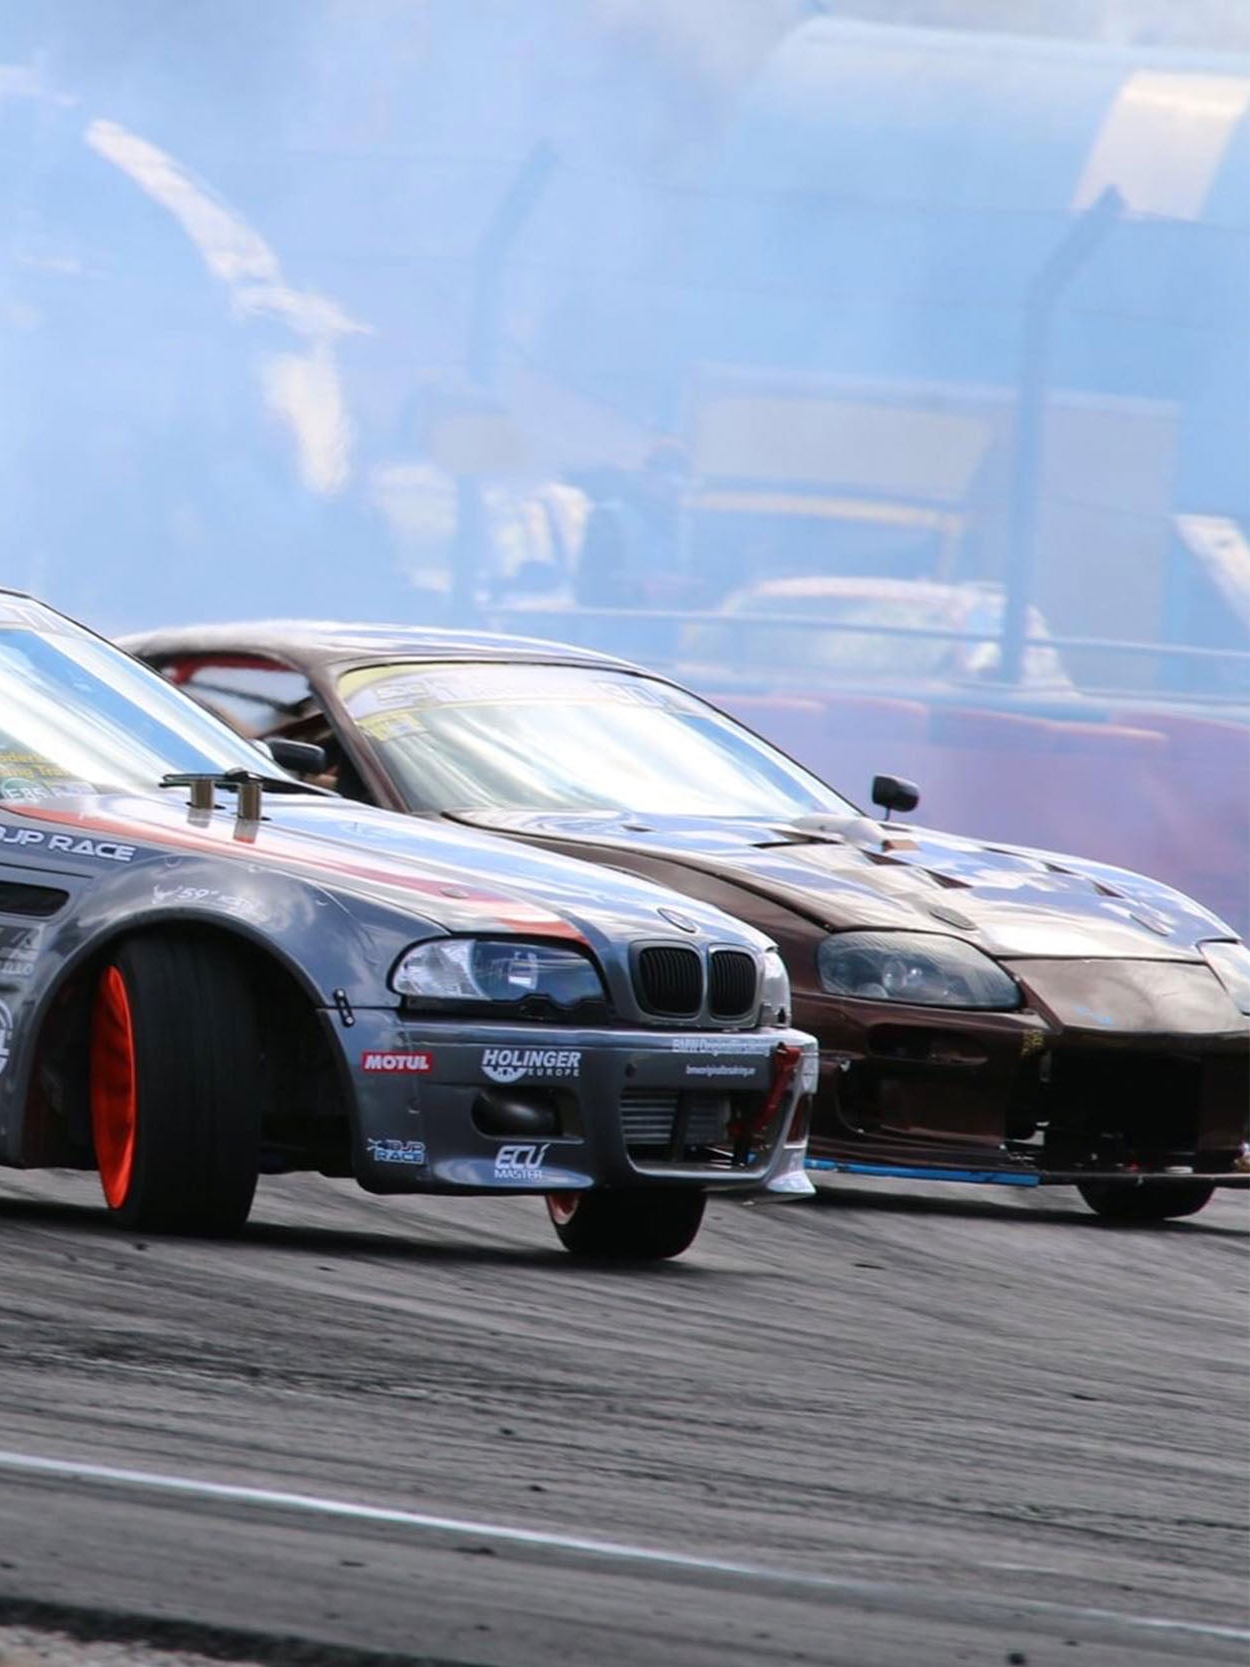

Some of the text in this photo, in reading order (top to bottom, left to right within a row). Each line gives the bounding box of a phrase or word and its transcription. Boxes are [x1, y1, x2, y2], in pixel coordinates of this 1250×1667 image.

[48, 835, 136, 862] RACE
[363, 1053, 430, 1071] MOTUL
[482, 1048, 582, 1069] HOLINGER
[495, 1143, 550, 1169] ECU
[494, 1168, 543, 1180] MASTER
